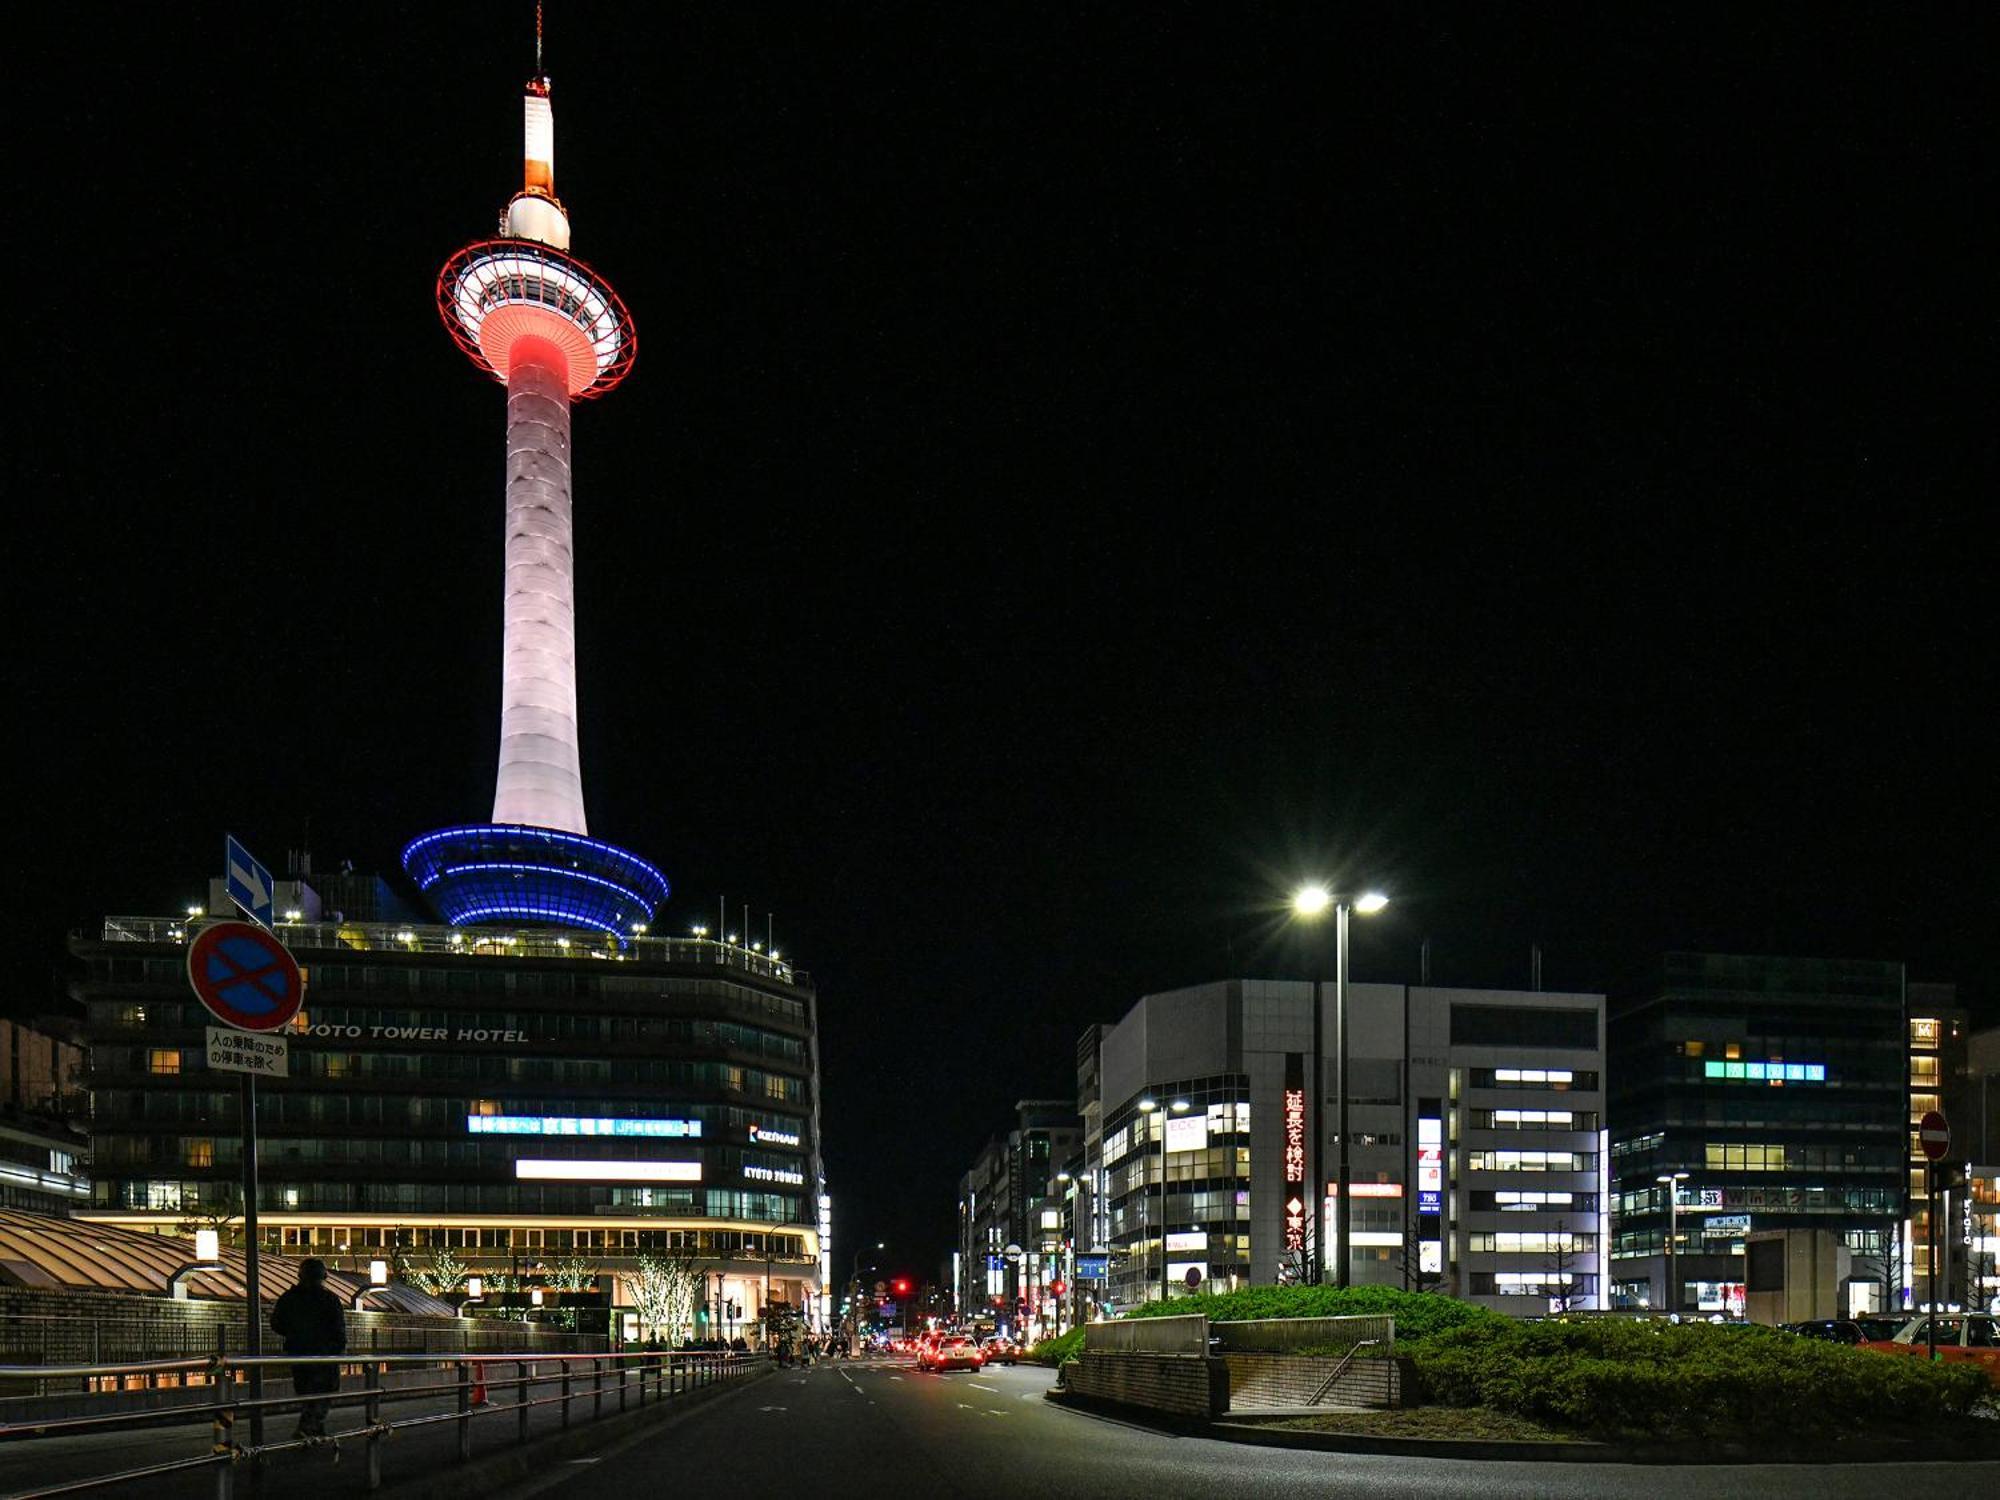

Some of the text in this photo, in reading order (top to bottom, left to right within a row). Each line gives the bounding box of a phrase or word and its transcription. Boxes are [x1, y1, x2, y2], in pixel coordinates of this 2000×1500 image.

[284, 1024, 529, 1043] KYOTO TOWER HOTEL
[211, 1032, 285, 1057] 人の乗降のため
[211, 1050, 274, 1071] の停車を除く
[1170, 1119, 1197, 1132] ECC
[757, 1130, 800, 1146] KEIHAN
[744, 1166, 804, 1185] KYOTO TOWER
[1963, 1199, 1973, 1244] KYOTO
